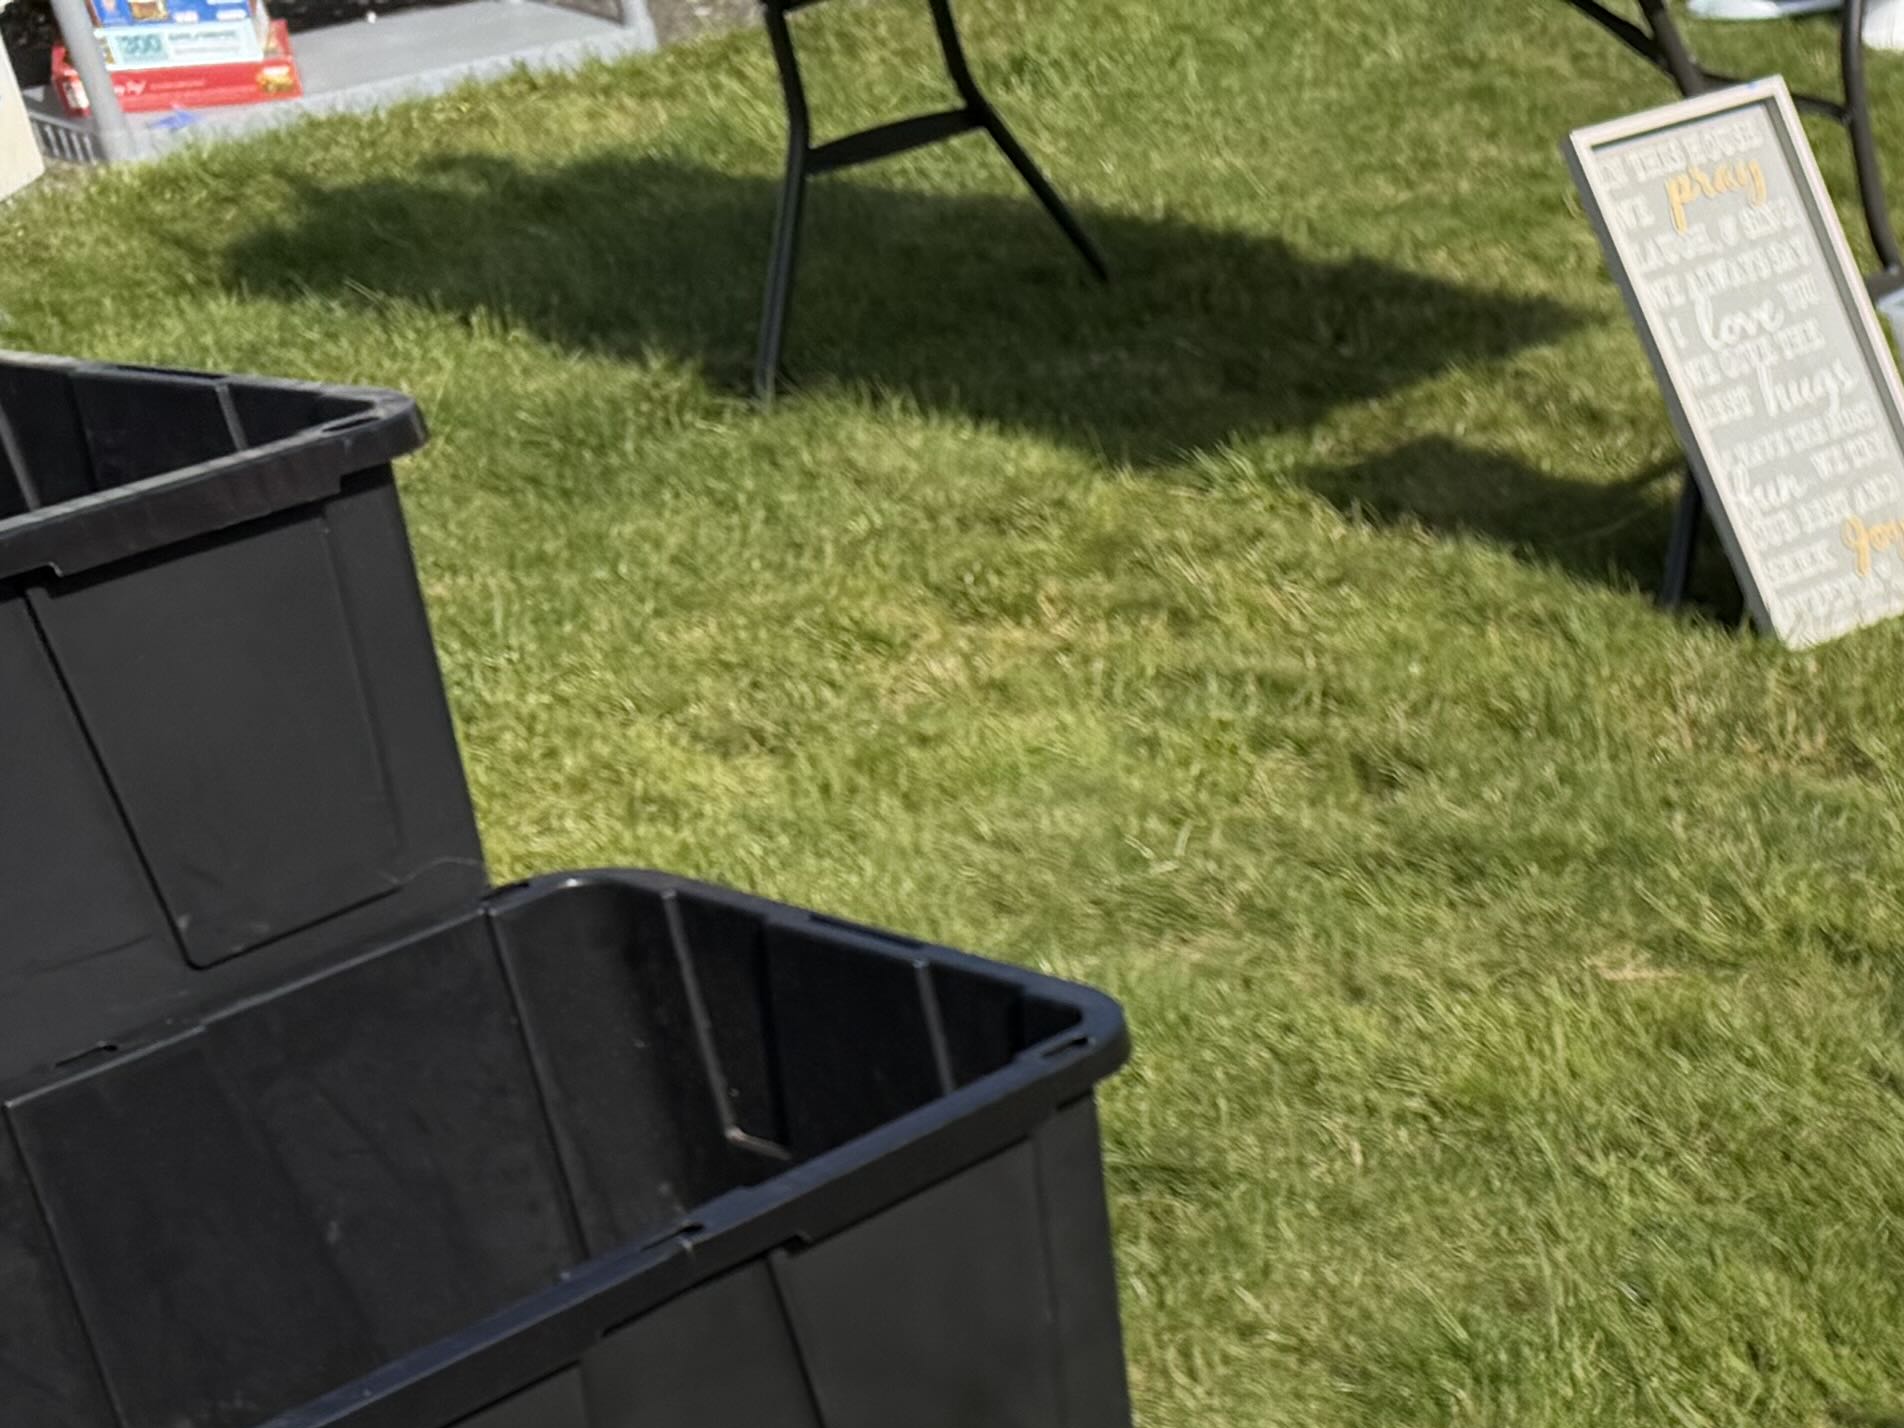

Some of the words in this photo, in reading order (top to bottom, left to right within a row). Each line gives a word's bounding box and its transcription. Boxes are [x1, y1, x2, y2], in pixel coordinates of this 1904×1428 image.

[1665, 159, 1767, 235] pray
[1694, 288, 1785, 351] love
[1756, 356, 1857, 418] hugs
[1730, 461, 1808, 507] fun
